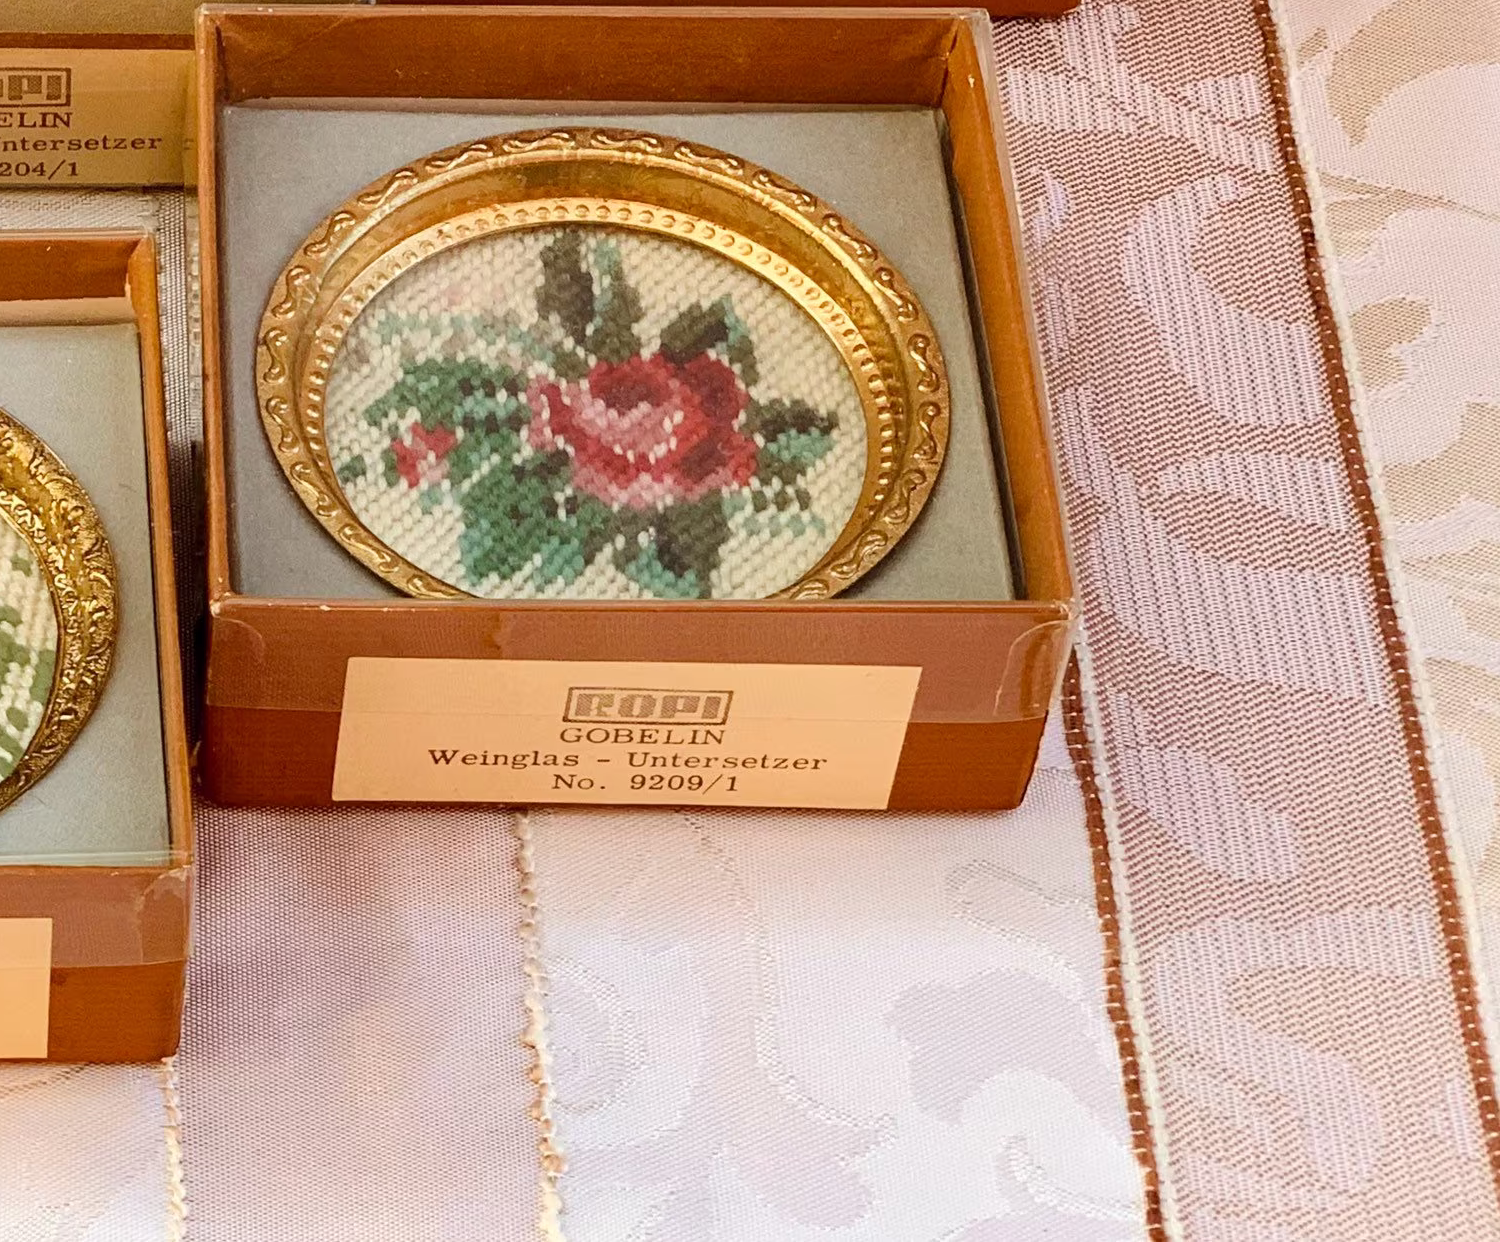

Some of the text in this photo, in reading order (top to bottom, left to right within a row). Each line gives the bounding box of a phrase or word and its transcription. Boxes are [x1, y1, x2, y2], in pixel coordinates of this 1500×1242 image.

[574, 693, 723, 719] ROPI
[560, 728, 724, 745] GOBELIN
[428, 749, 579, 769] Weinglas
[627, 751, 827, 771] Untersetzer
[551, 774, 738, 792] No. 9209/1
